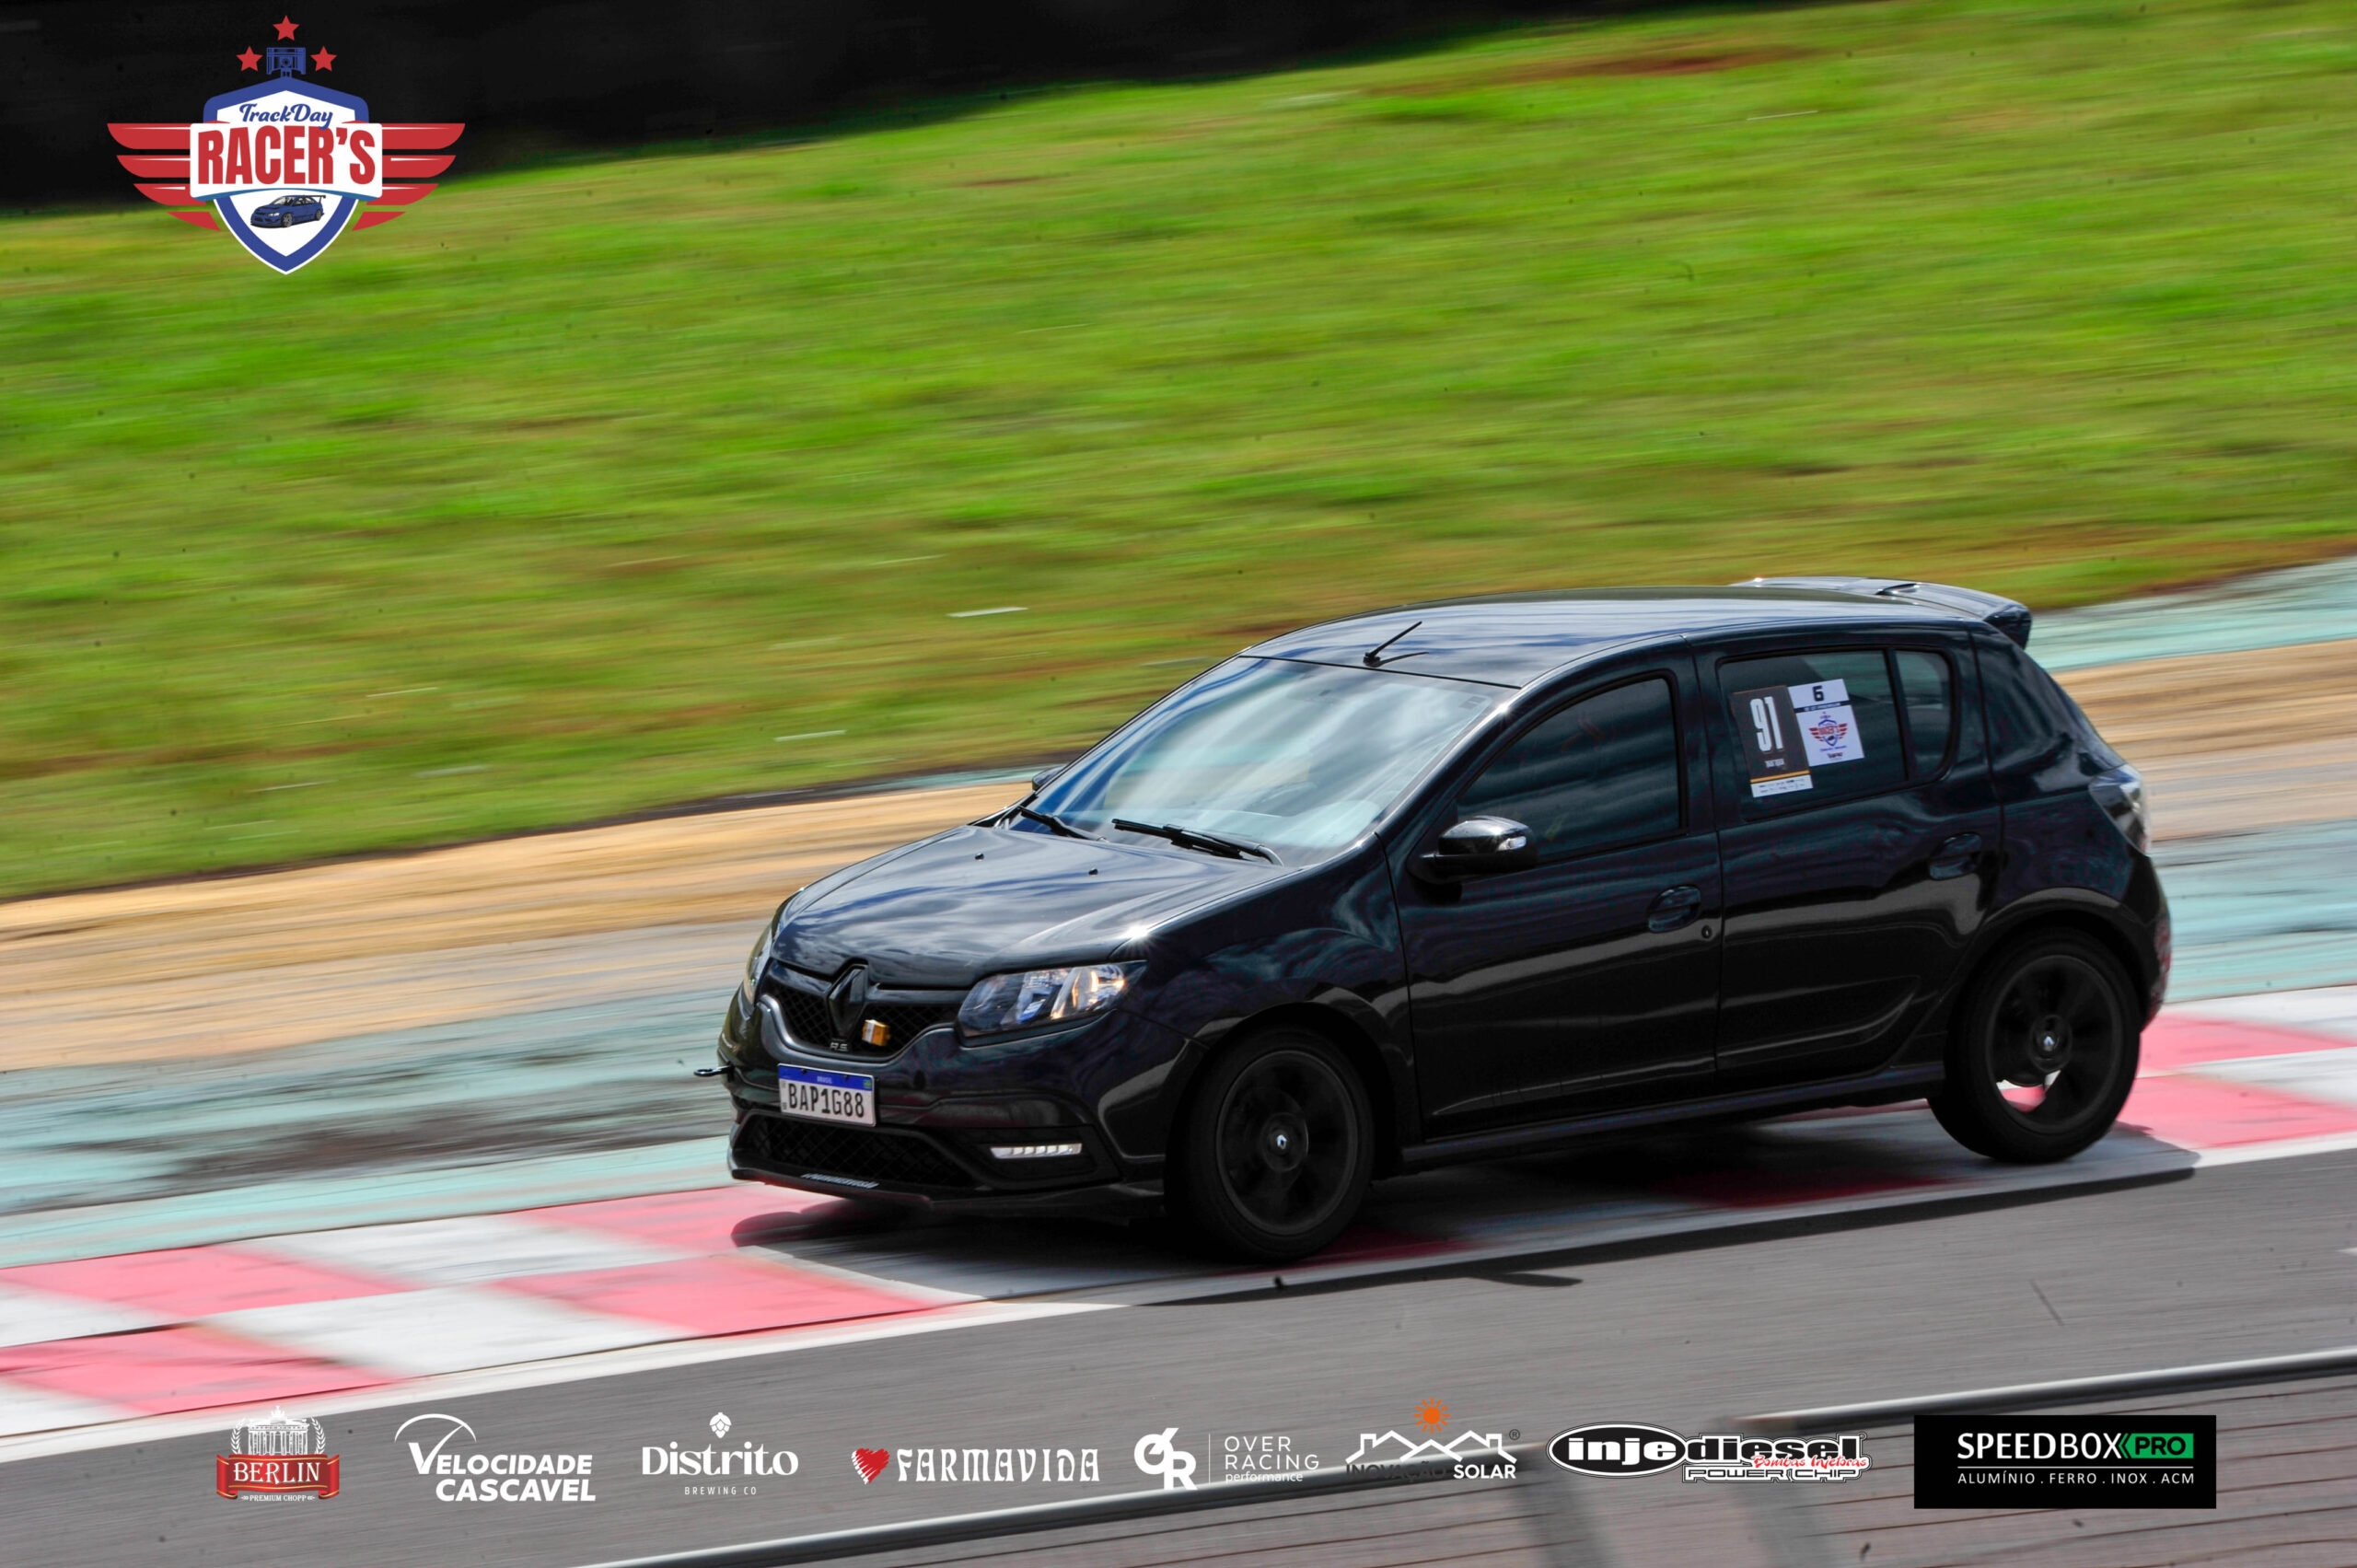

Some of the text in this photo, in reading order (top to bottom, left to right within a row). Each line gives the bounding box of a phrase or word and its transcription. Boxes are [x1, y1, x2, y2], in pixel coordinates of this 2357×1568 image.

[1812, 685, 1825, 702] 6
[1750, 696, 1783, 752] 91
[788, 1083, 865, 1118] BAP1G88
